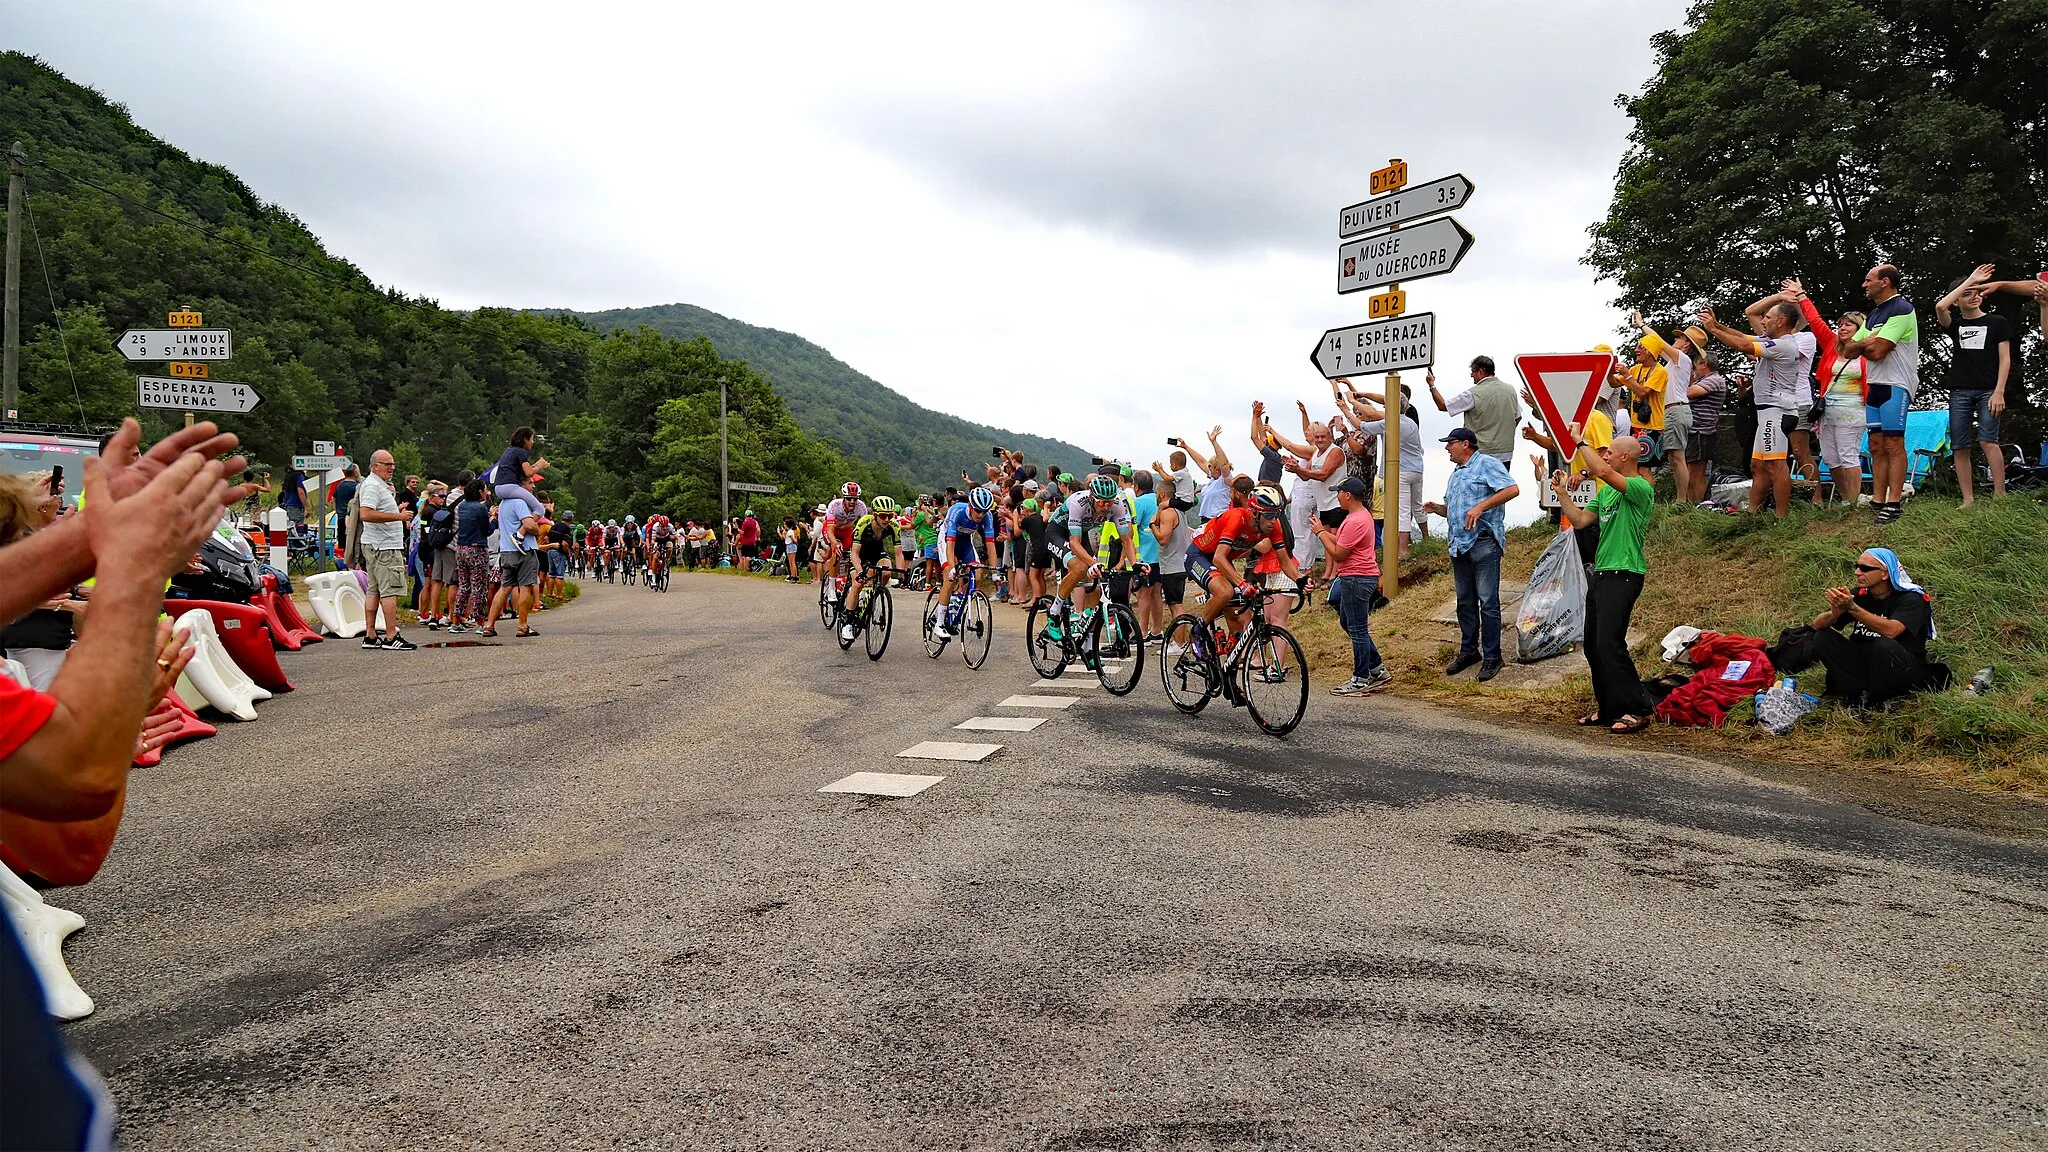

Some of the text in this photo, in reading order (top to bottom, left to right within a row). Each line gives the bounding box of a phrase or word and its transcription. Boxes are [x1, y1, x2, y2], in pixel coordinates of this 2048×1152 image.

[1344, 186, 1456, 230] PUIVERT 3,5
[1359, 237, 1400, 262] MUSÉE
[1358, 248, 1447, 282] DU QUERCORB
[132, 335, 225, 344] 25 LIMOUX
[1330, 322, 1427, 352] 14 ESPÉRAZA
[140, 347, 146, 356] 9
[182, 347, 226, 356] ANDRE
[1336, 343, 1427, 370] 7 ROUVENAC
[143, 381, 245, 396] ESPERAZA 14
[144, 394, 245, 408] ROUVENAC 7
[1764, 420, 1772, 452] weldom
[1552, 495, 1588, 503] PAGE
[1047, 542, 1063, 559] BORA
[1223, 620, 1254, 673] MERIDA
